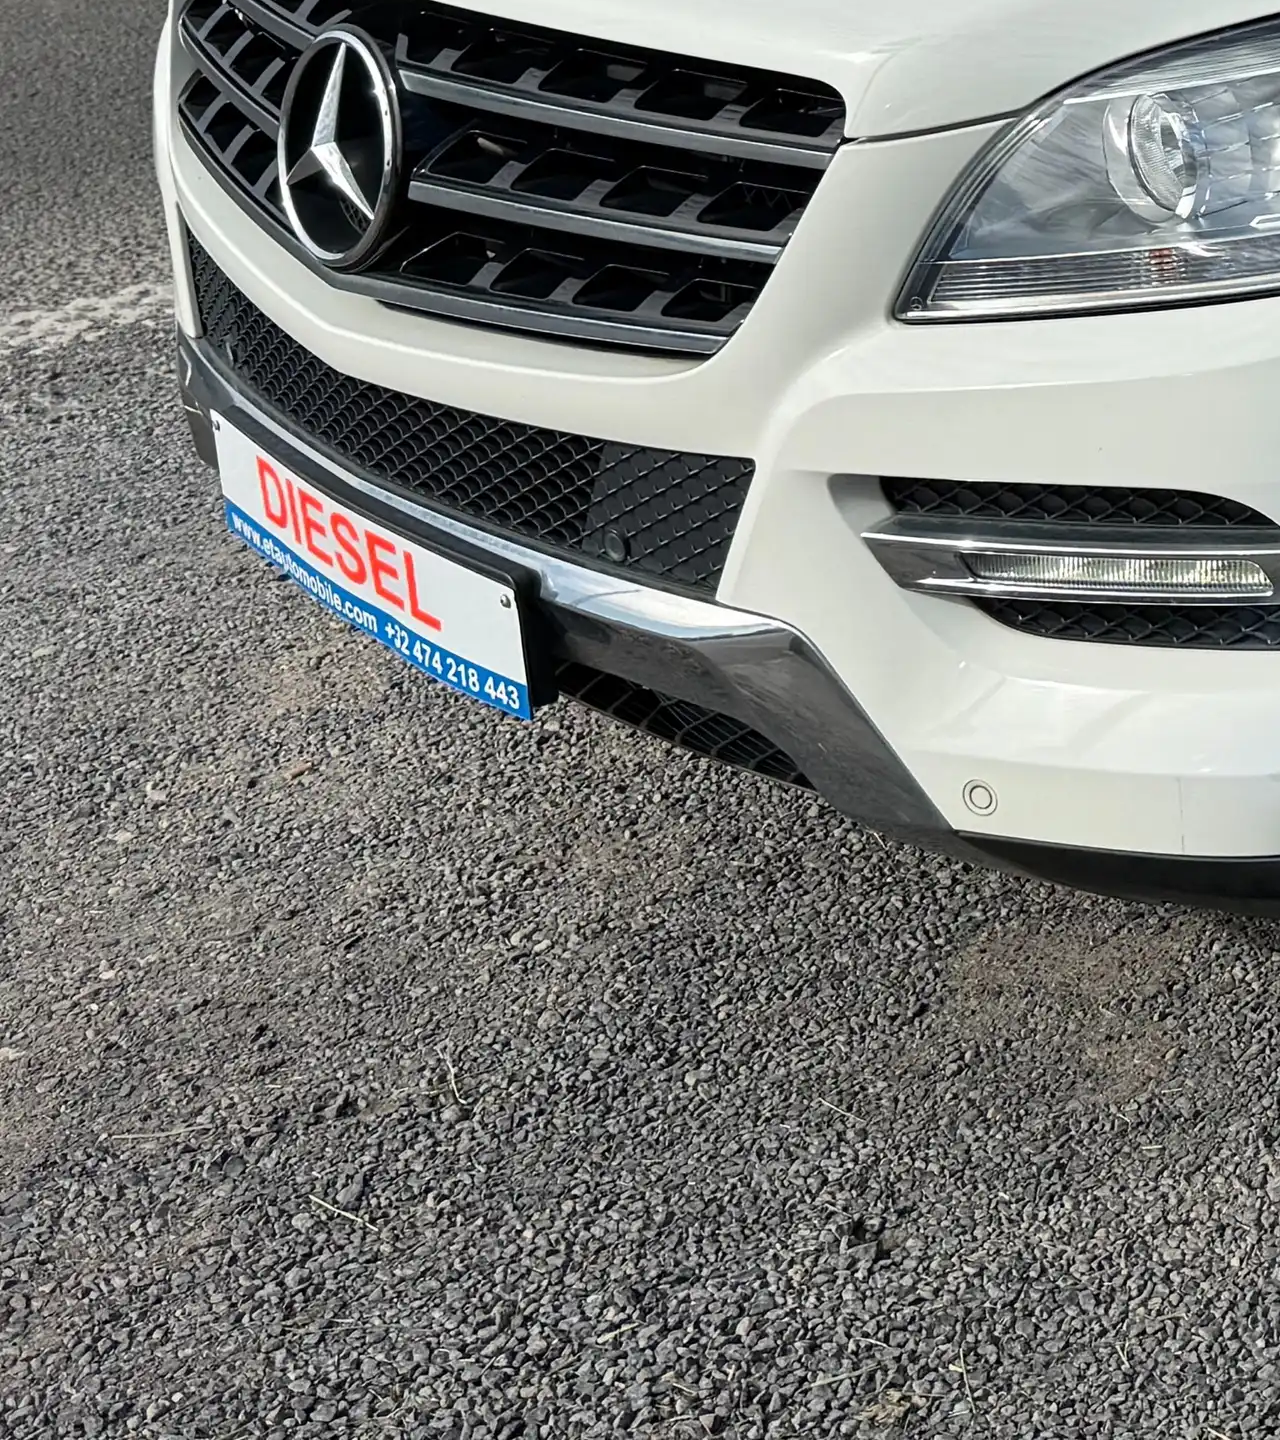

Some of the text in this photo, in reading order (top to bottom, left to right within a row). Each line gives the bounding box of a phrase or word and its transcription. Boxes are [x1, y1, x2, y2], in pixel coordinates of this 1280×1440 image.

[256, 455, 442, 632] DIESEL
[385, 622, 410, 656] +32
[413, 641, 443, 675] 474
[446, 658, 479, 693] 218
[484, 677, 520, 710] 443
